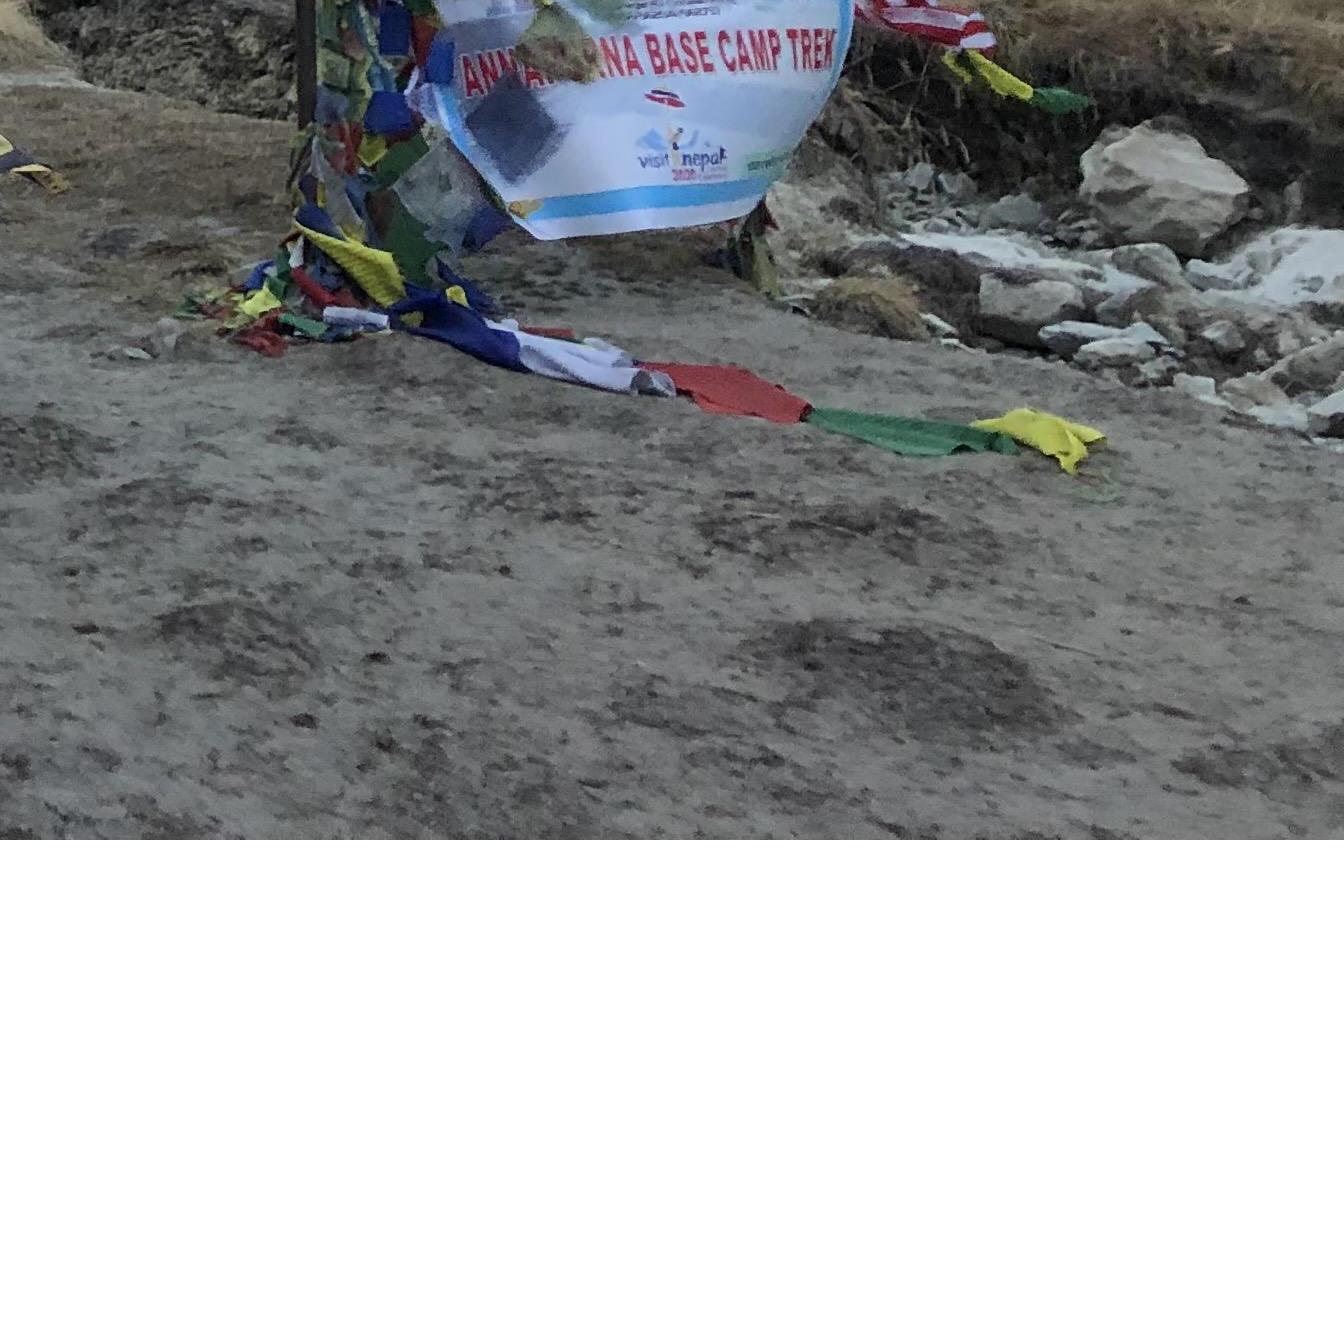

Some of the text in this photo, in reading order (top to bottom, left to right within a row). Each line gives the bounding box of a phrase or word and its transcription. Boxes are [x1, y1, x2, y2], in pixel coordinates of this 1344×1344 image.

[643, 29, 713, 76] BASE
[716, 28, 780, 73] CAMP
[786, 26, 838, 73] TREK
